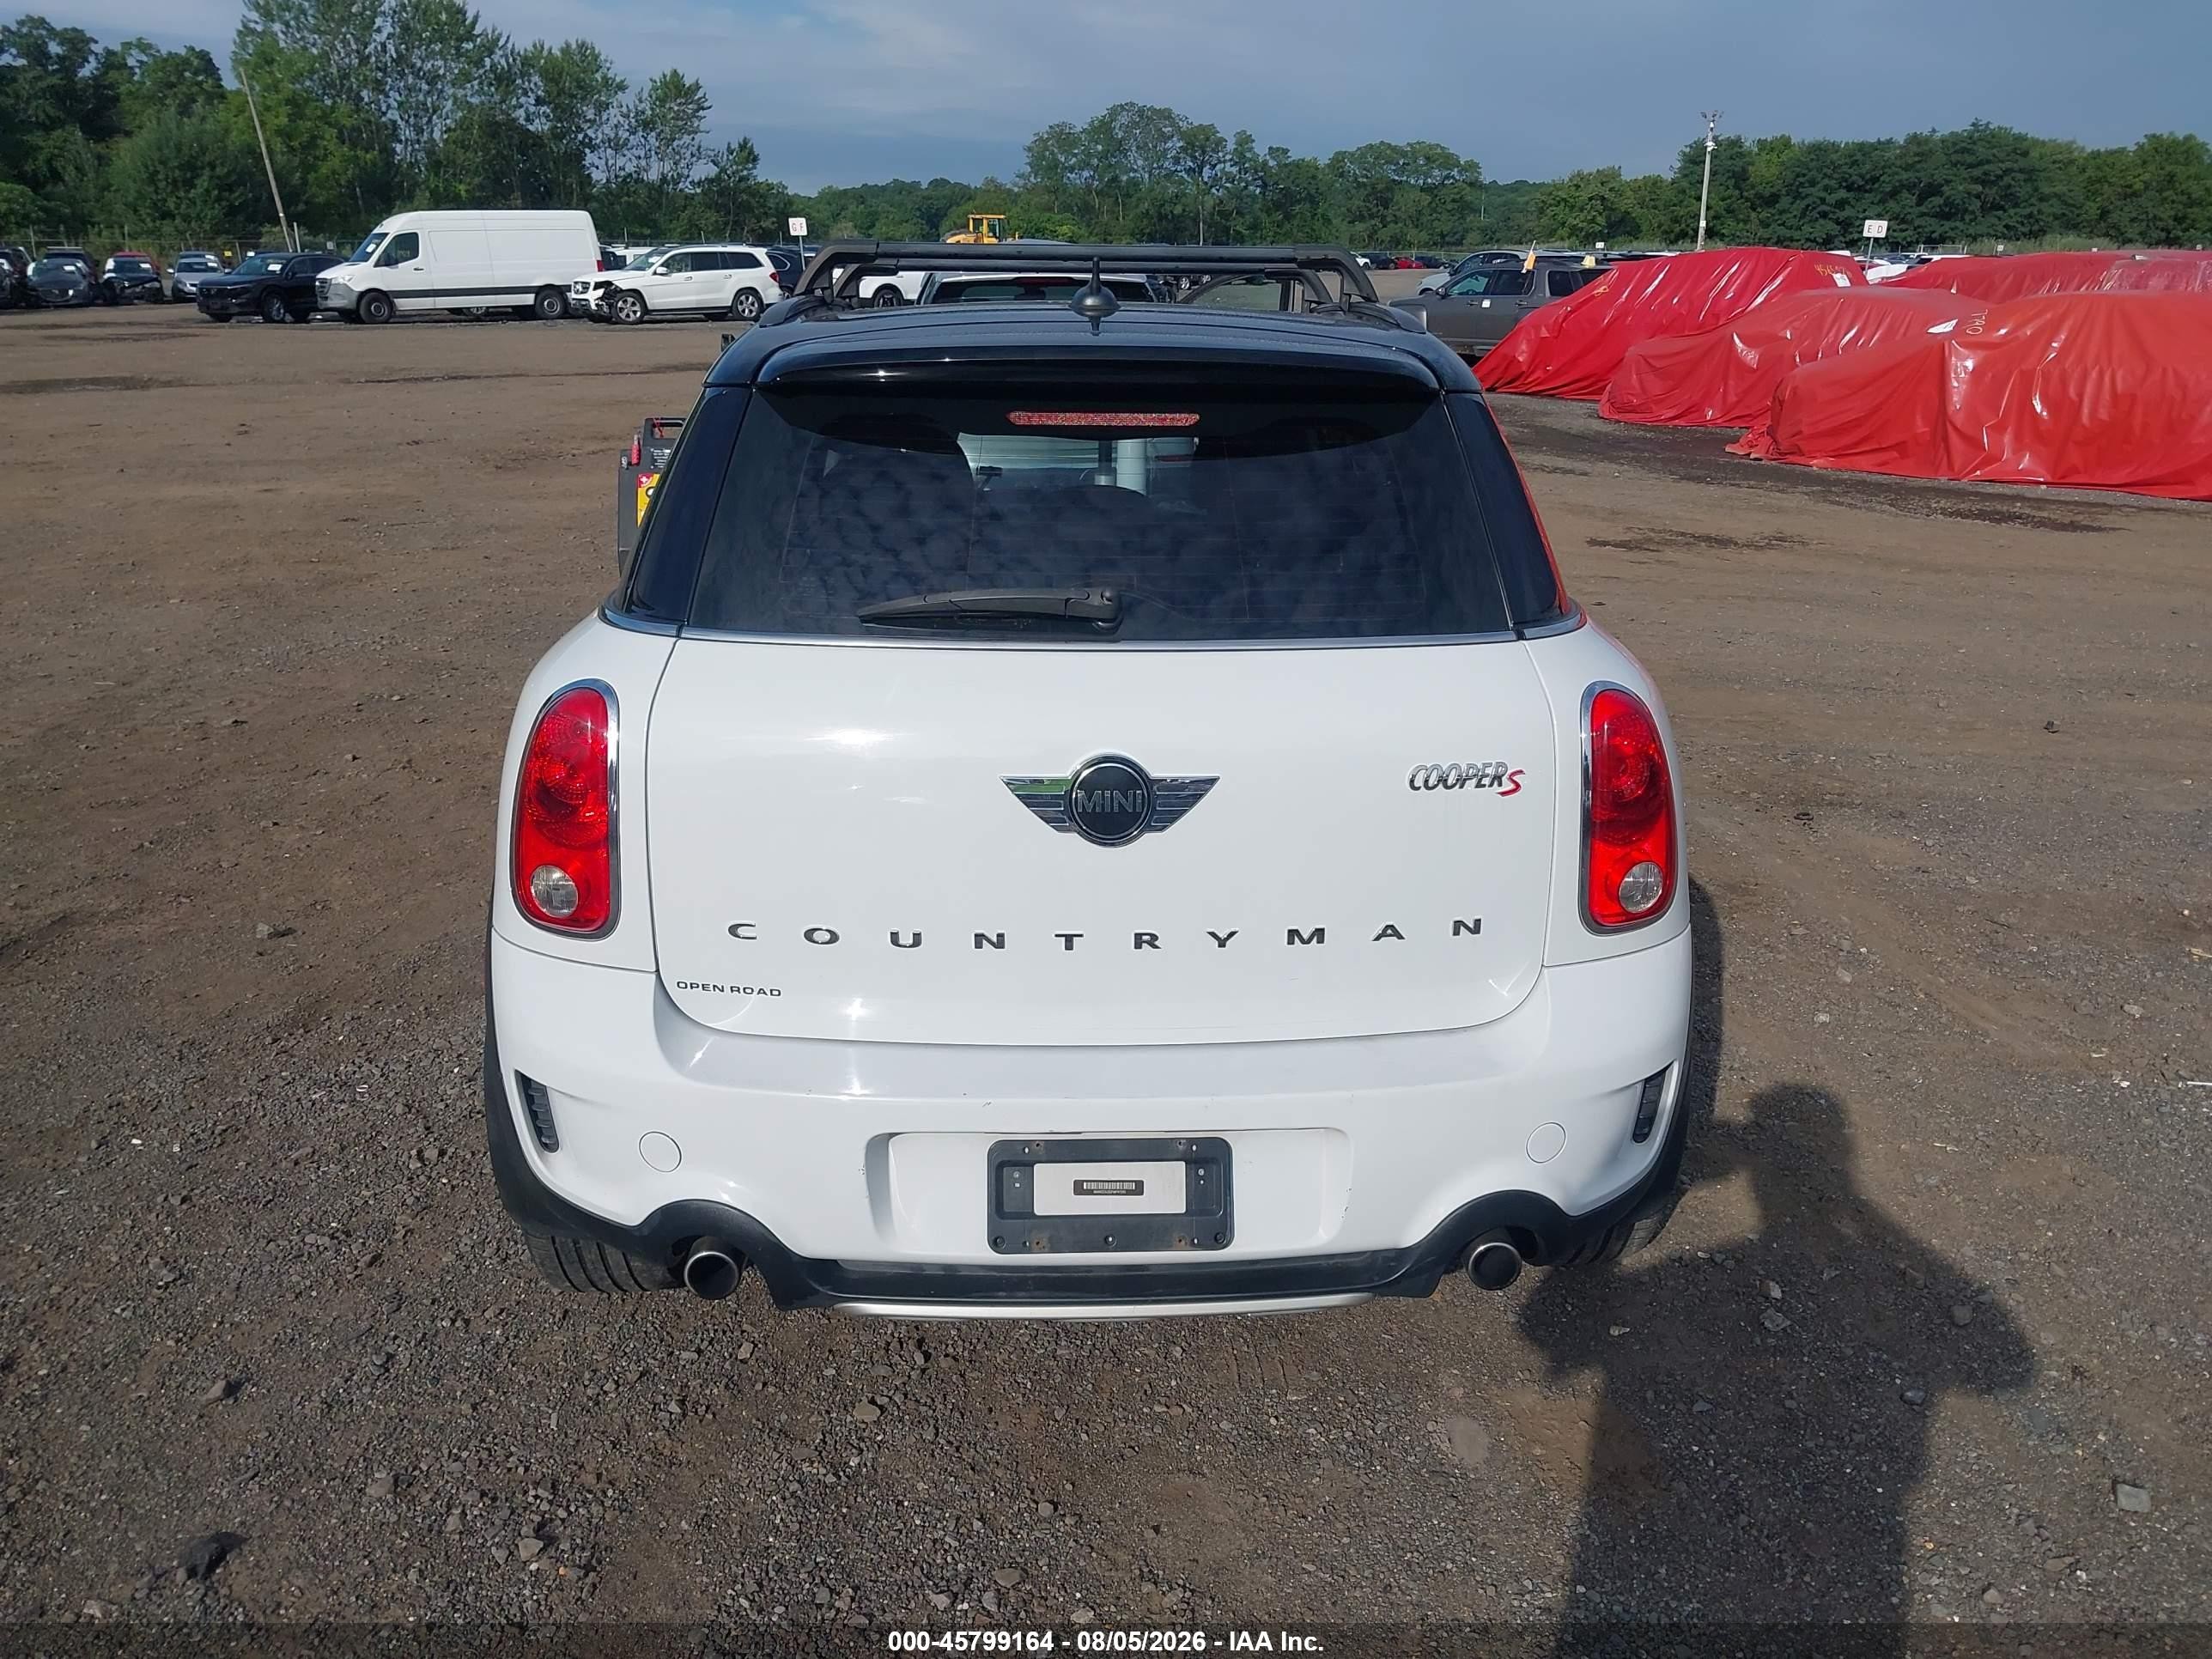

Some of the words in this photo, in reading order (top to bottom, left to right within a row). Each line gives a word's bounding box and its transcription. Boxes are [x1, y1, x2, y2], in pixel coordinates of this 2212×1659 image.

[1408, 762, 1509, 792] COOPER
[1496, 769, 1526, 797] S
[1077, 789, 1143, 813] MINI
[727, 917, 1482, 951] COUNTRYMAN
[676, 980, 725, 994] OPEN
[729, 985, 782, 998] ROAD
